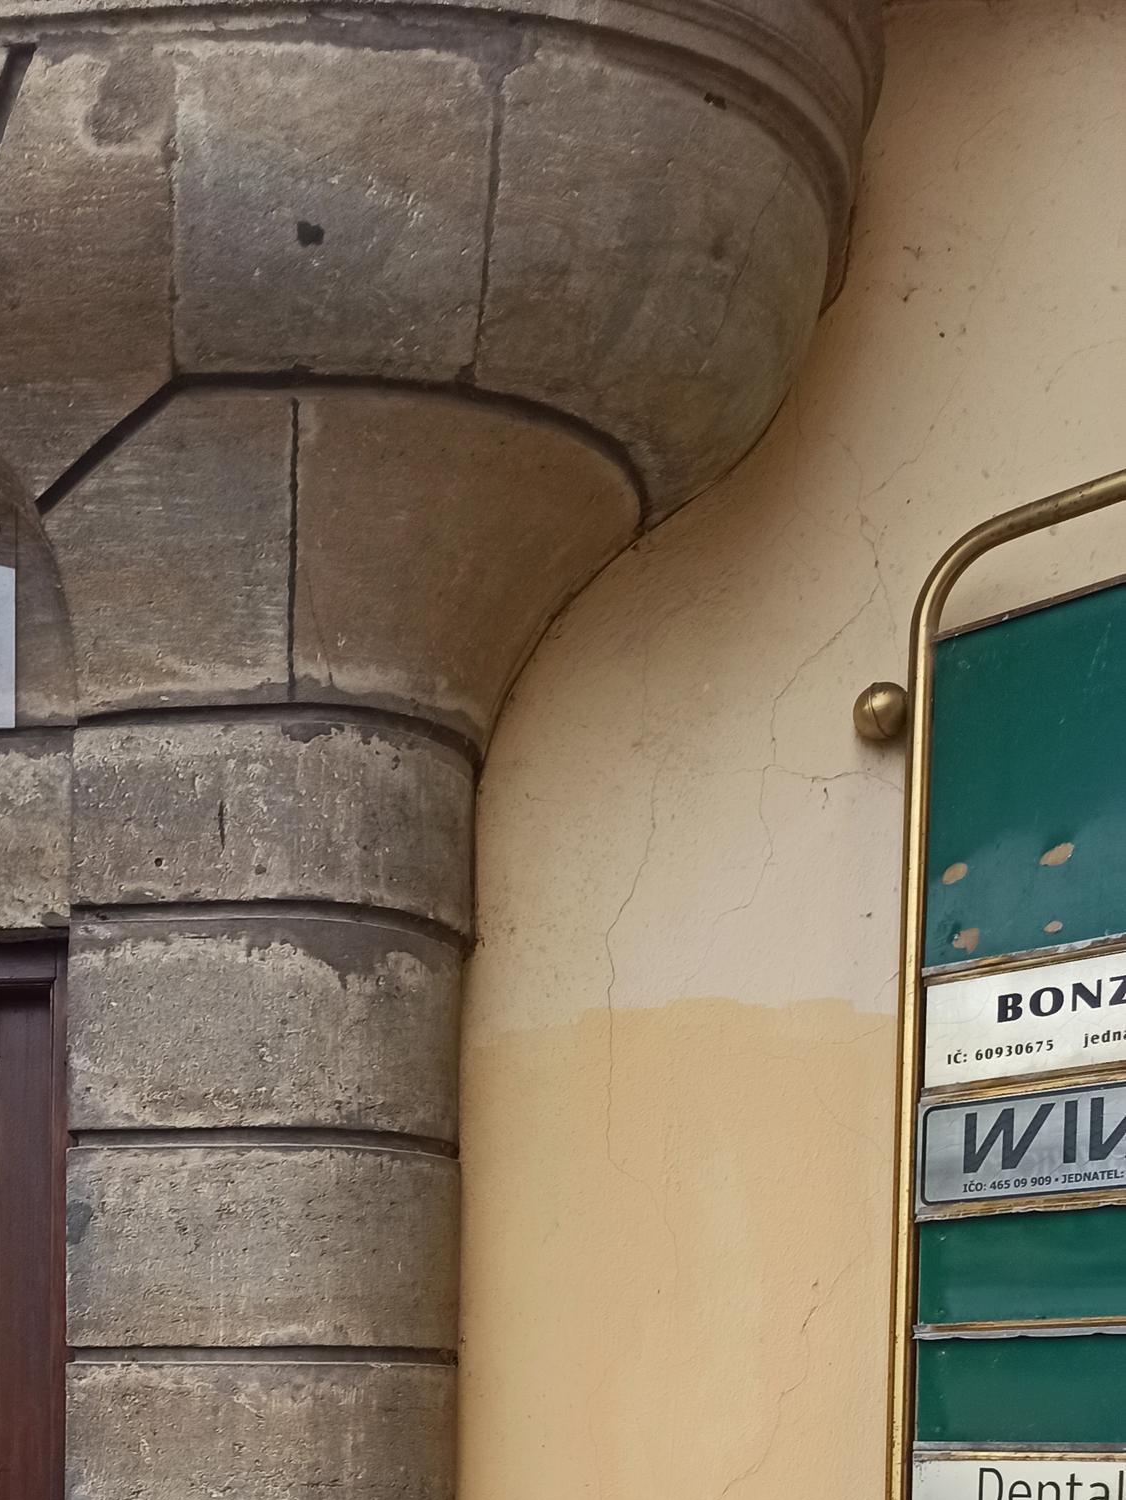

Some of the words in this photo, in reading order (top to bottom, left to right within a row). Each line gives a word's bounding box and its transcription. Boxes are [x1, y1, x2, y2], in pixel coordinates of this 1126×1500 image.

[947, 1050, 968, 1065] IČ:
[975, 1039, 1054, 1061] 60930675
[1083, 1030, 1126, 1049] jedn
[962, 1180, 987, 1193] IČO:
[989, 1179, 1011, 1191] 465
[1013, 1177, 1028, 1189] 09
[1030, 1175, 1052, 1187] 909
[1061, 1169, 1125, 1184] JEDNATEL:
